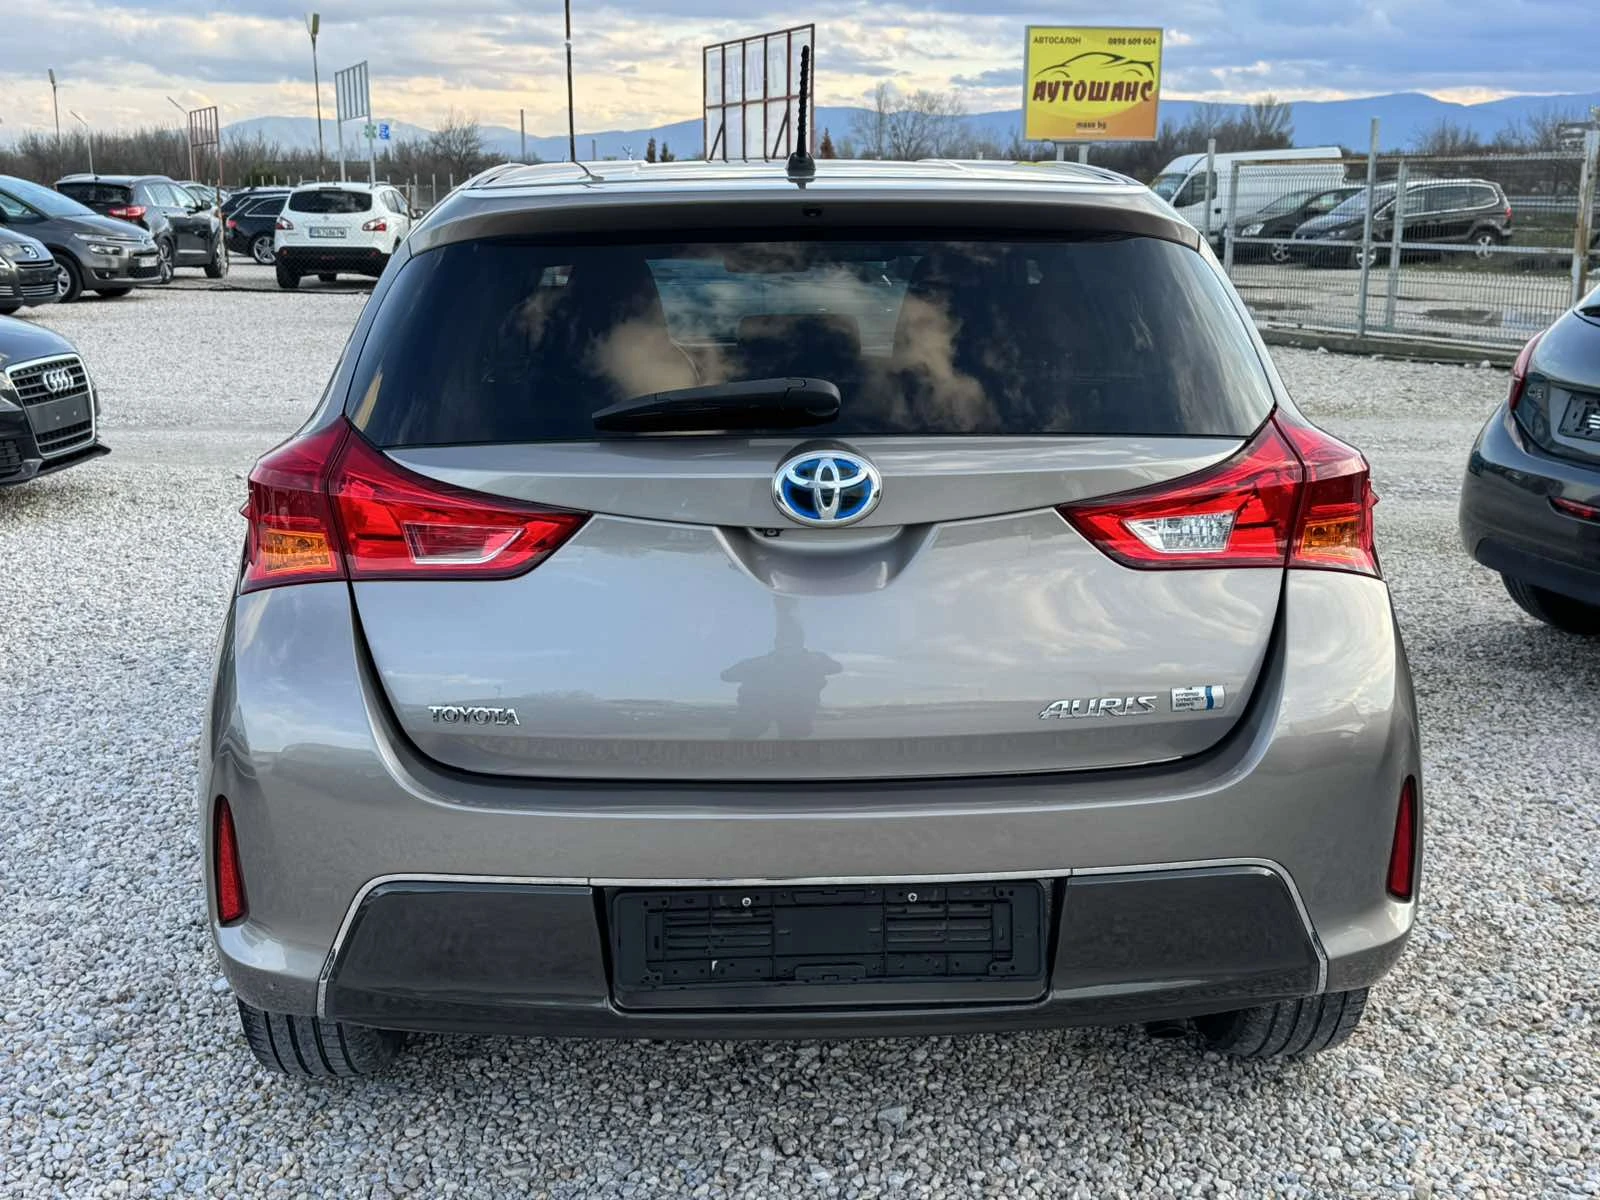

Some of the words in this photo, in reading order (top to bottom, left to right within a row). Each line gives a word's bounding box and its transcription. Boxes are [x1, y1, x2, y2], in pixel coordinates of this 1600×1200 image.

[1033, 36, 1082, 45] АВТОСАЛОН
[1032, 80, 1154, 102] АУТОШАНС
[428, 705, 520, 726] TOYOTA
[1039, 695, 1157, 720] AURIS
